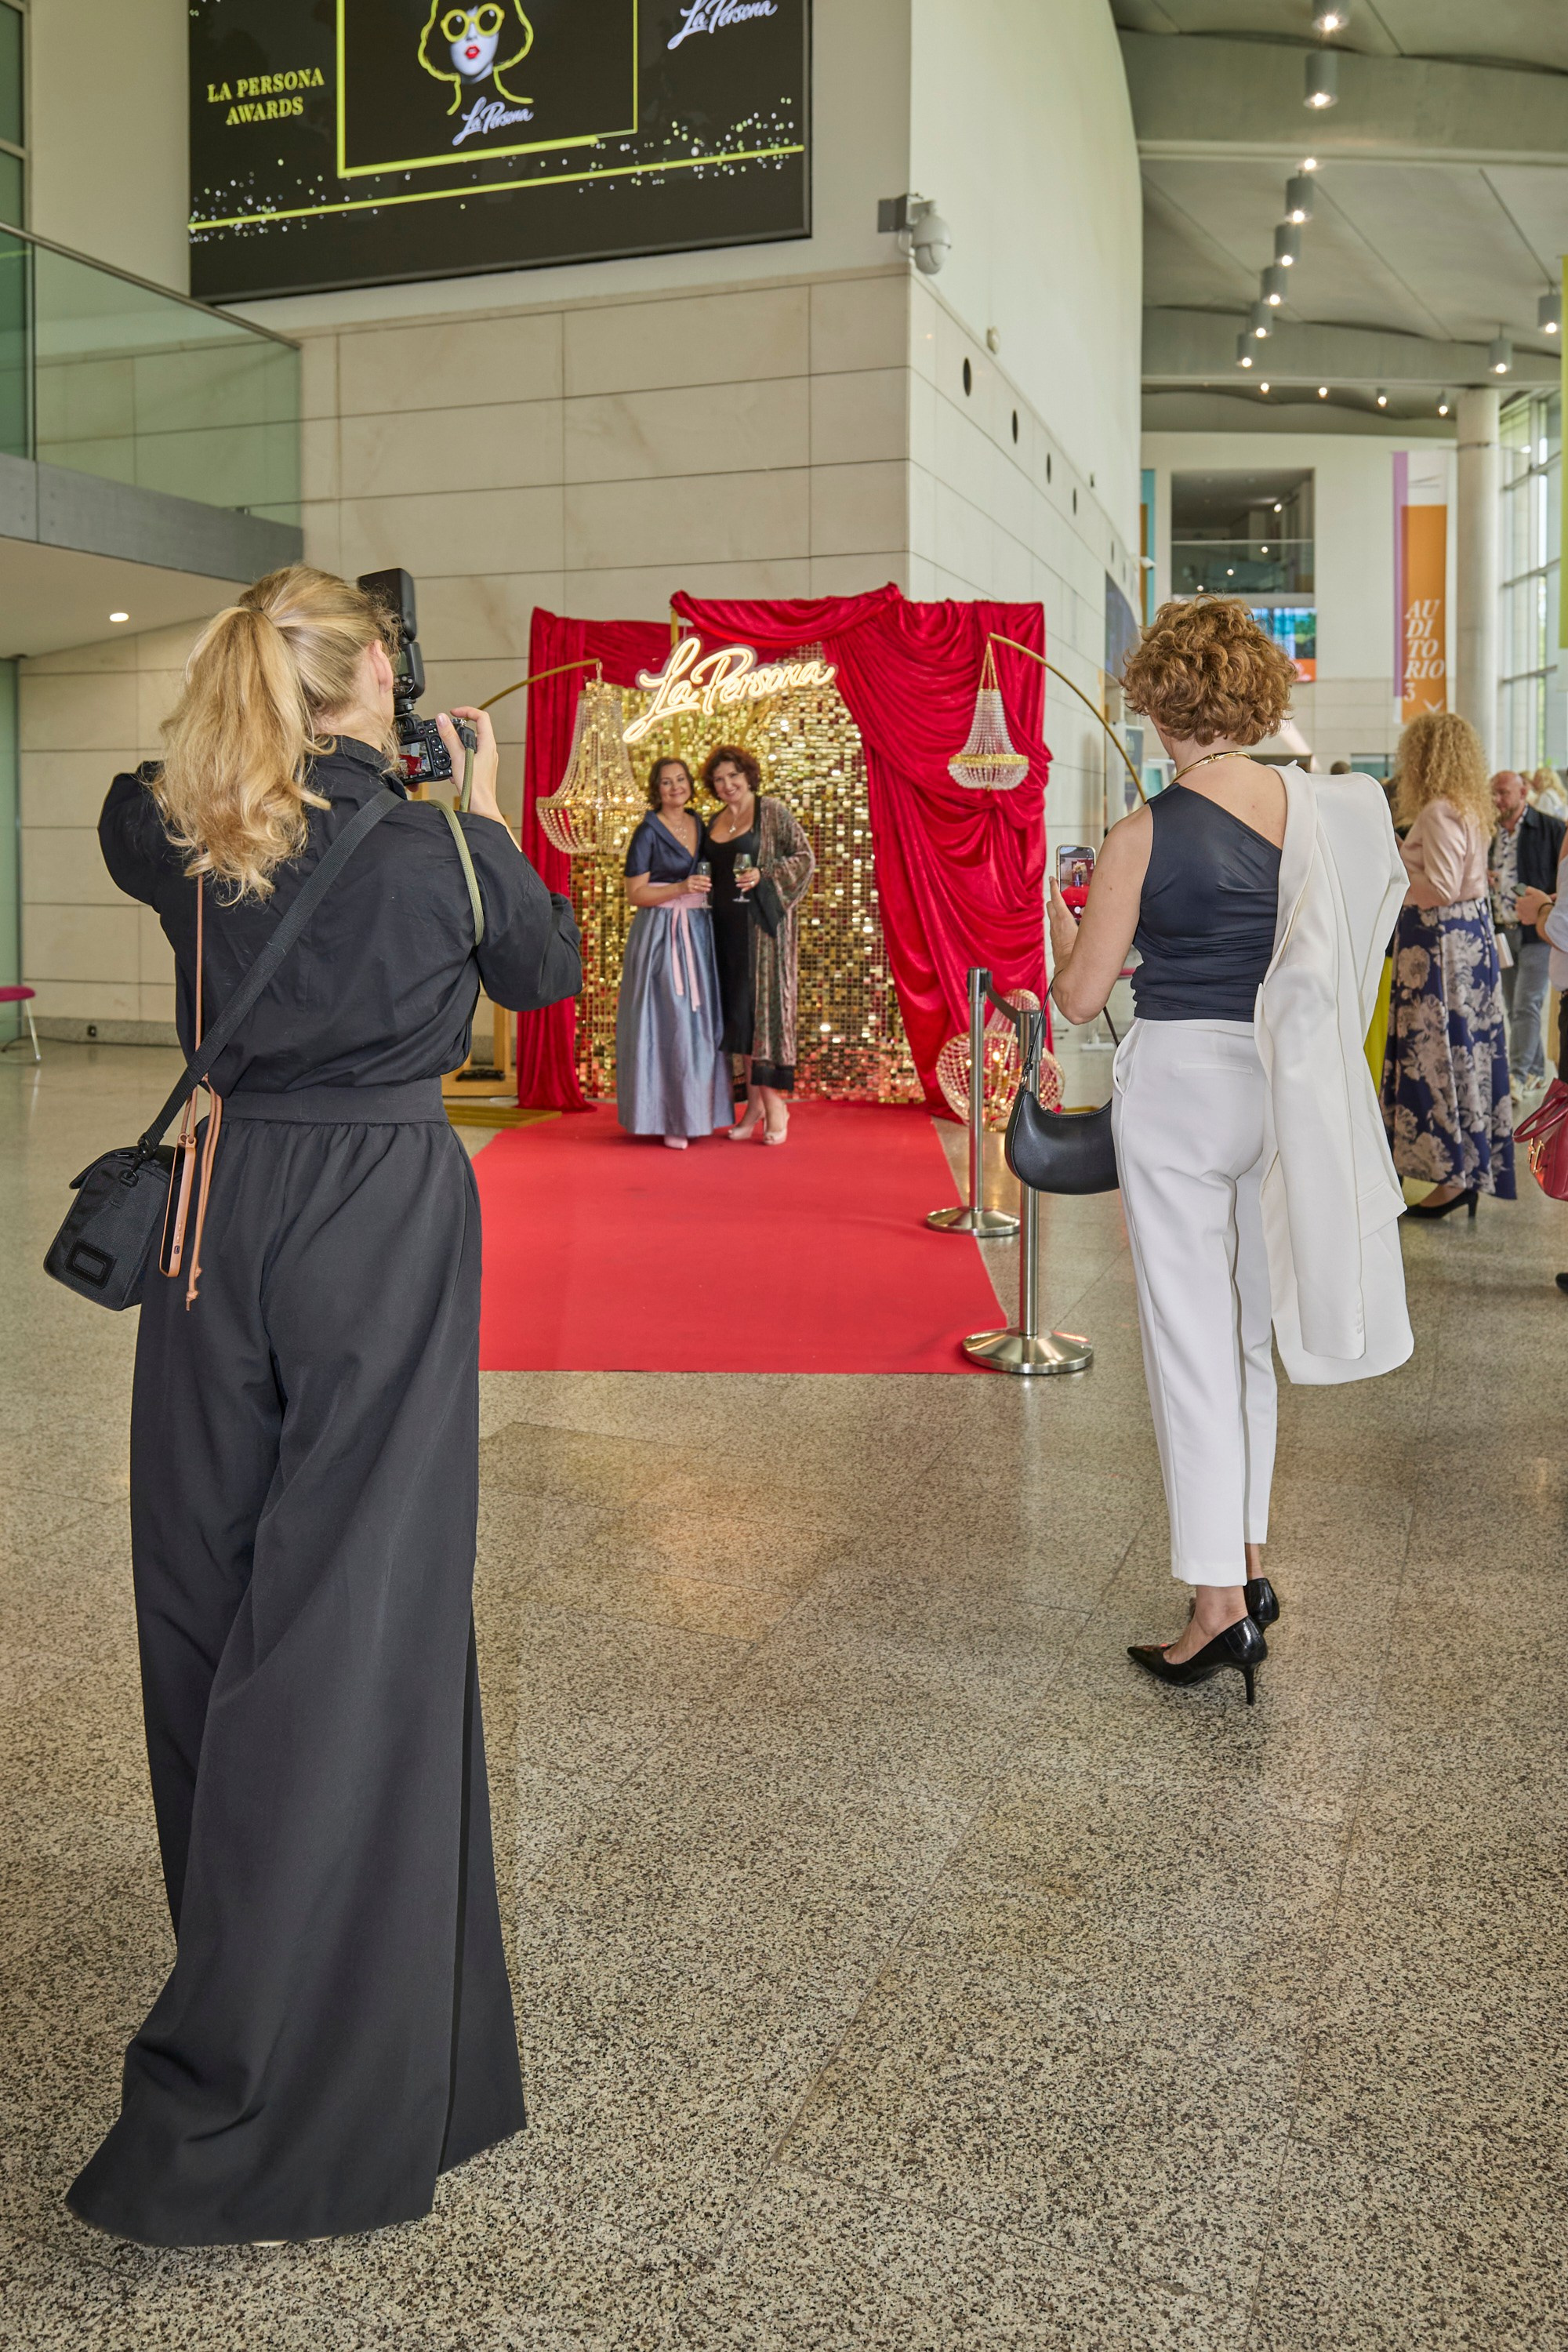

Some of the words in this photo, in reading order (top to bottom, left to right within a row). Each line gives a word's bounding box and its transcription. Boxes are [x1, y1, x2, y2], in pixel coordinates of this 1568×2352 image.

[207, 82, 233, 103] LA
[236, 67, 325, 99] PERSONA
[225, 96, 304, 126] AWARDS
[1404, 599, 1441, 619] AU
[1406, 619, 1434, 639] DI
[1408, 639, 1439, 659] TO
[1404, 659, 1445, 680] RIO
[622, 637, 702, 744] La
[690, 647, 836, 717] Persona
[1403, 682, 1416, 702] 3
